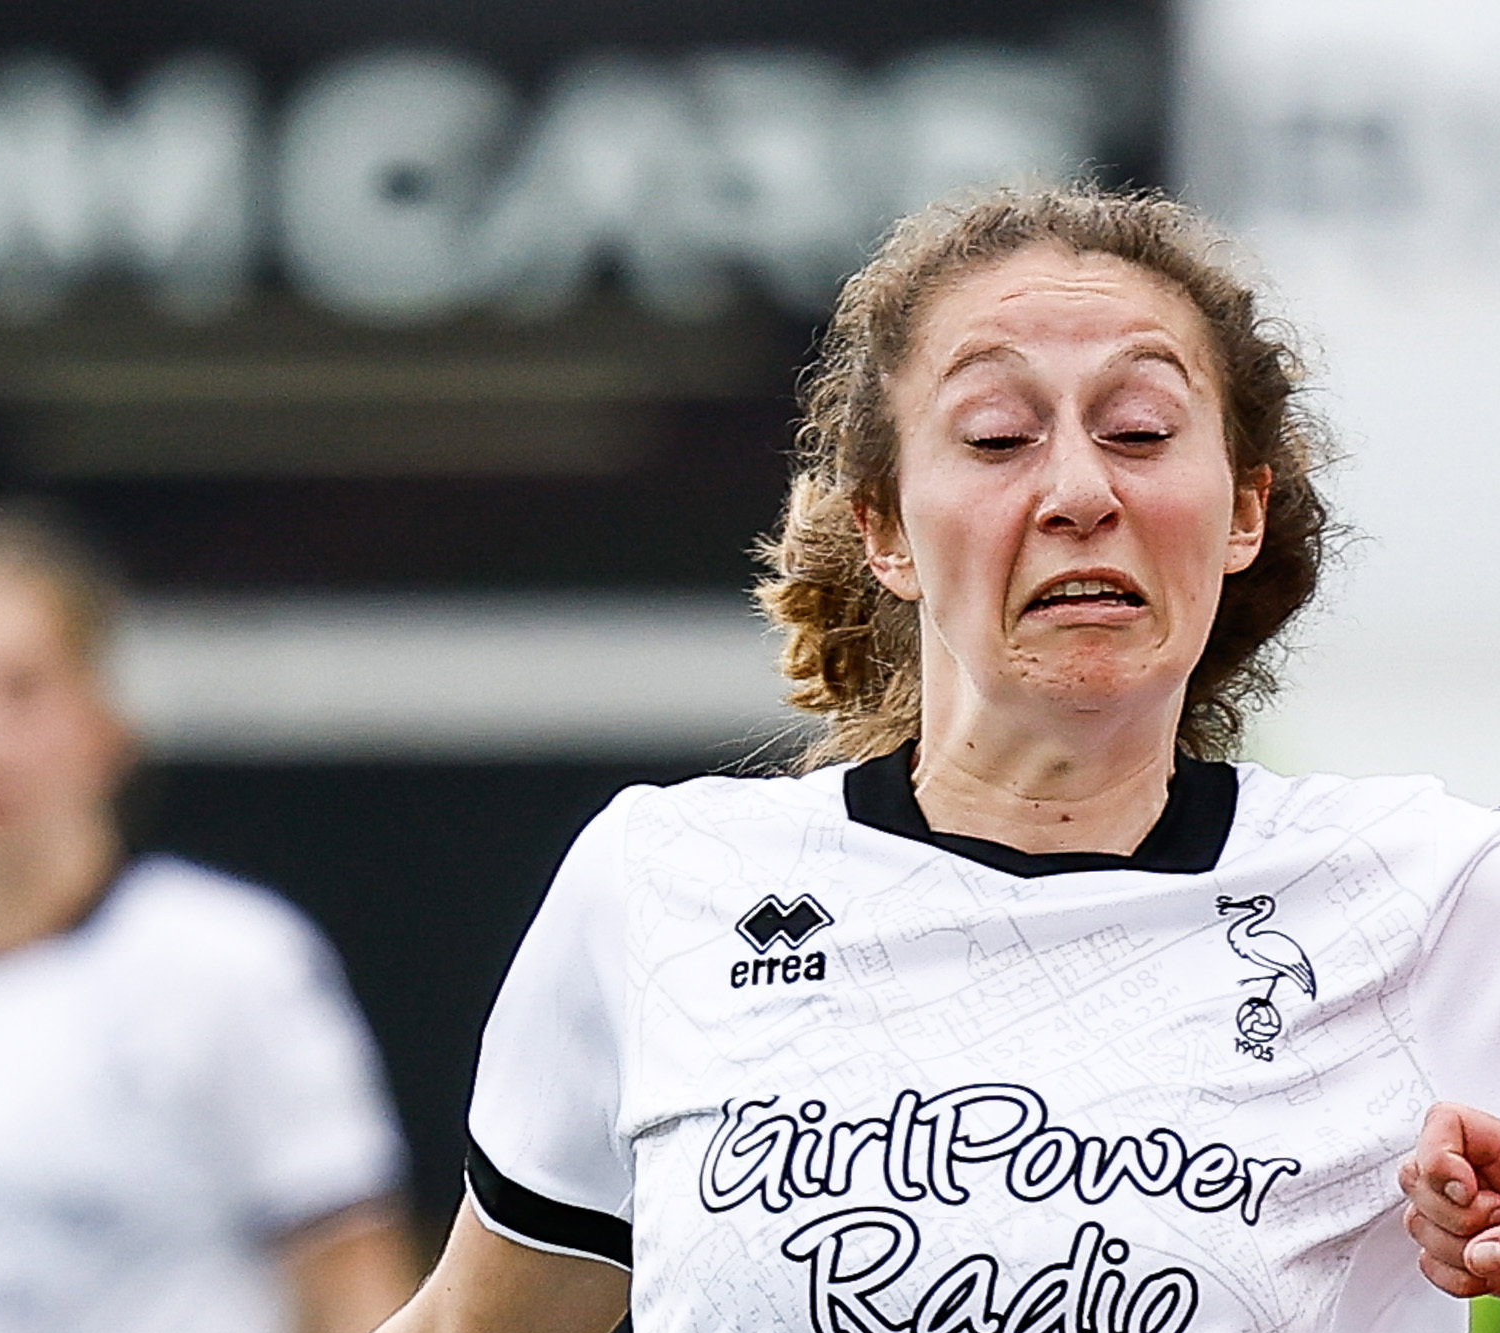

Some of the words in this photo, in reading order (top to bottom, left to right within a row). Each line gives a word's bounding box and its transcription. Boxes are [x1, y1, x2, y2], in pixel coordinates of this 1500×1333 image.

[729, 950, 828, 989] errea
[1234, 1037, 1275, 1062] 1905
[698, 1081, 1302, 1226] GirlPower
